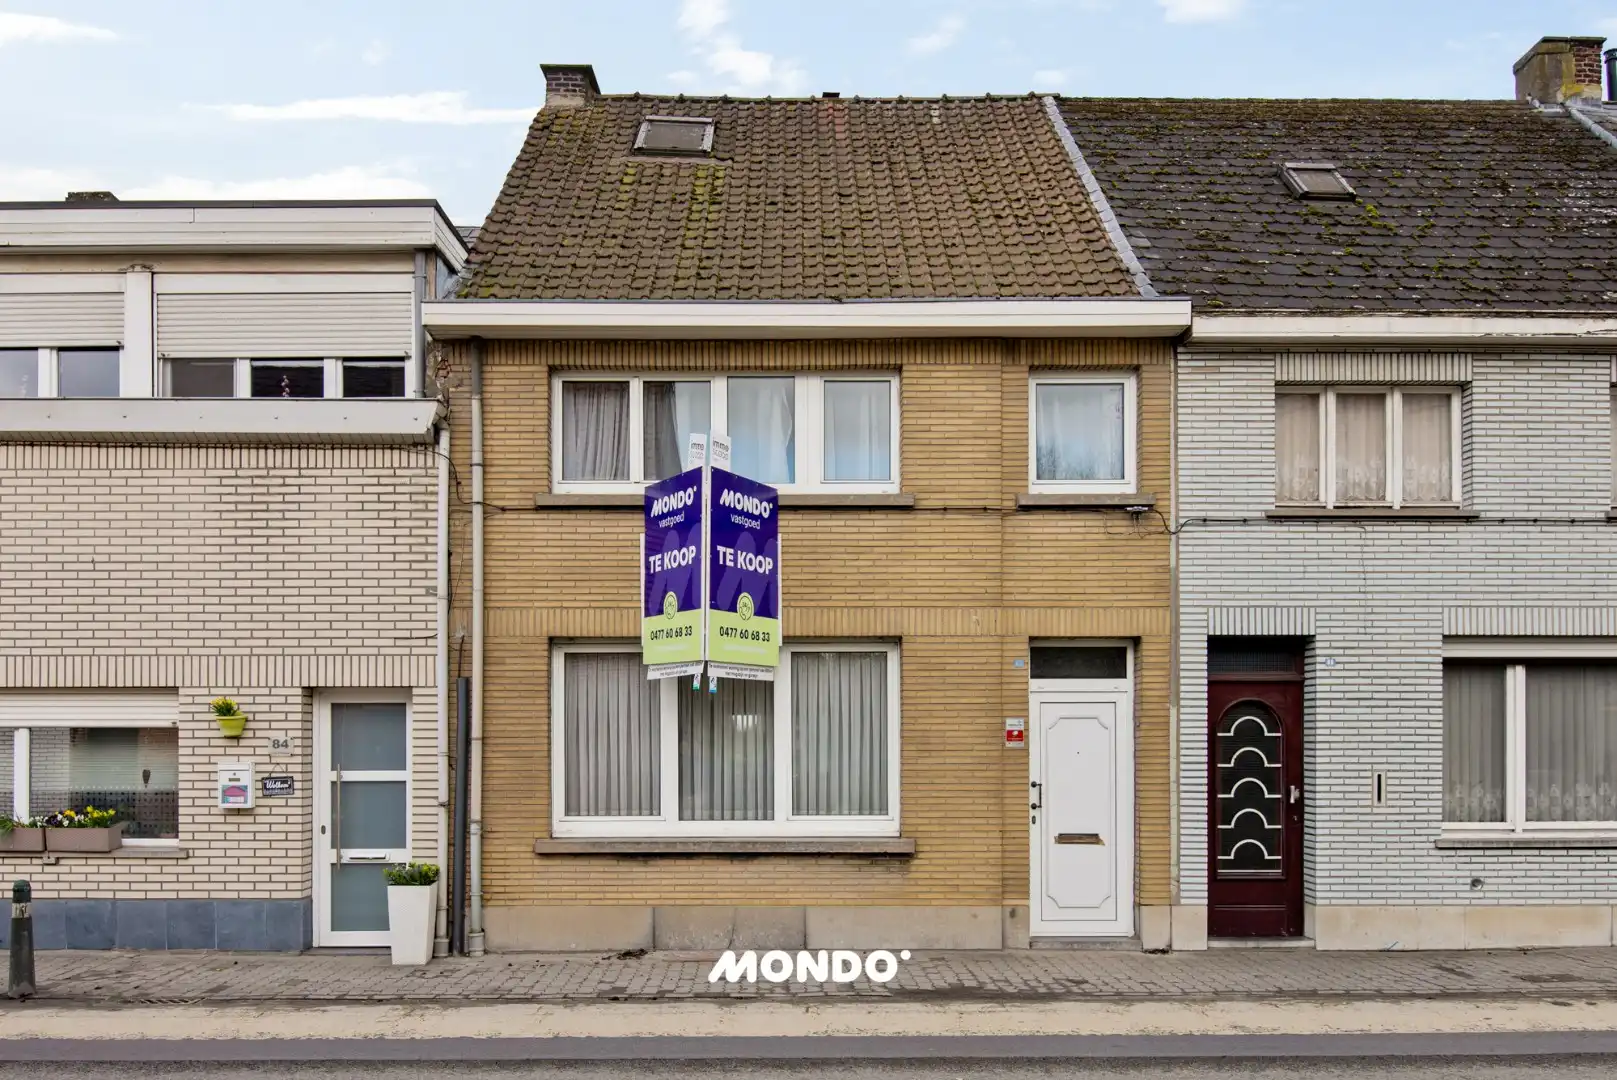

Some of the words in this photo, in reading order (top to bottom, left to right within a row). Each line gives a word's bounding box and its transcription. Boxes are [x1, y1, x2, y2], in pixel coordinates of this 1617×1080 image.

[651, 486, 695, 518] MONDO
[720, 489, 771, 519] MONDO
[658, 511, 685, 528] vastgoed
[730, 513, 761, 530] vastgoed
[649, 554, 662, 574] TE
[664, 545, 697, 570] KOOP
[717, 545, 735, 567] TE
[737, 550, 774, 575] KOOP
[650, 629, 664, 641] 0477
[665, 628, 673, 639] 60
[674, 627, 683, 638] 68
[684, 625, 693, 636] 33
[719, 626, 738, 639] 0477
[739, 629, 749, 640] 60
[750, 631, 760, 641] 68
[761, 632, 771, 642] 33
[272, 738, 290, 749] 84
